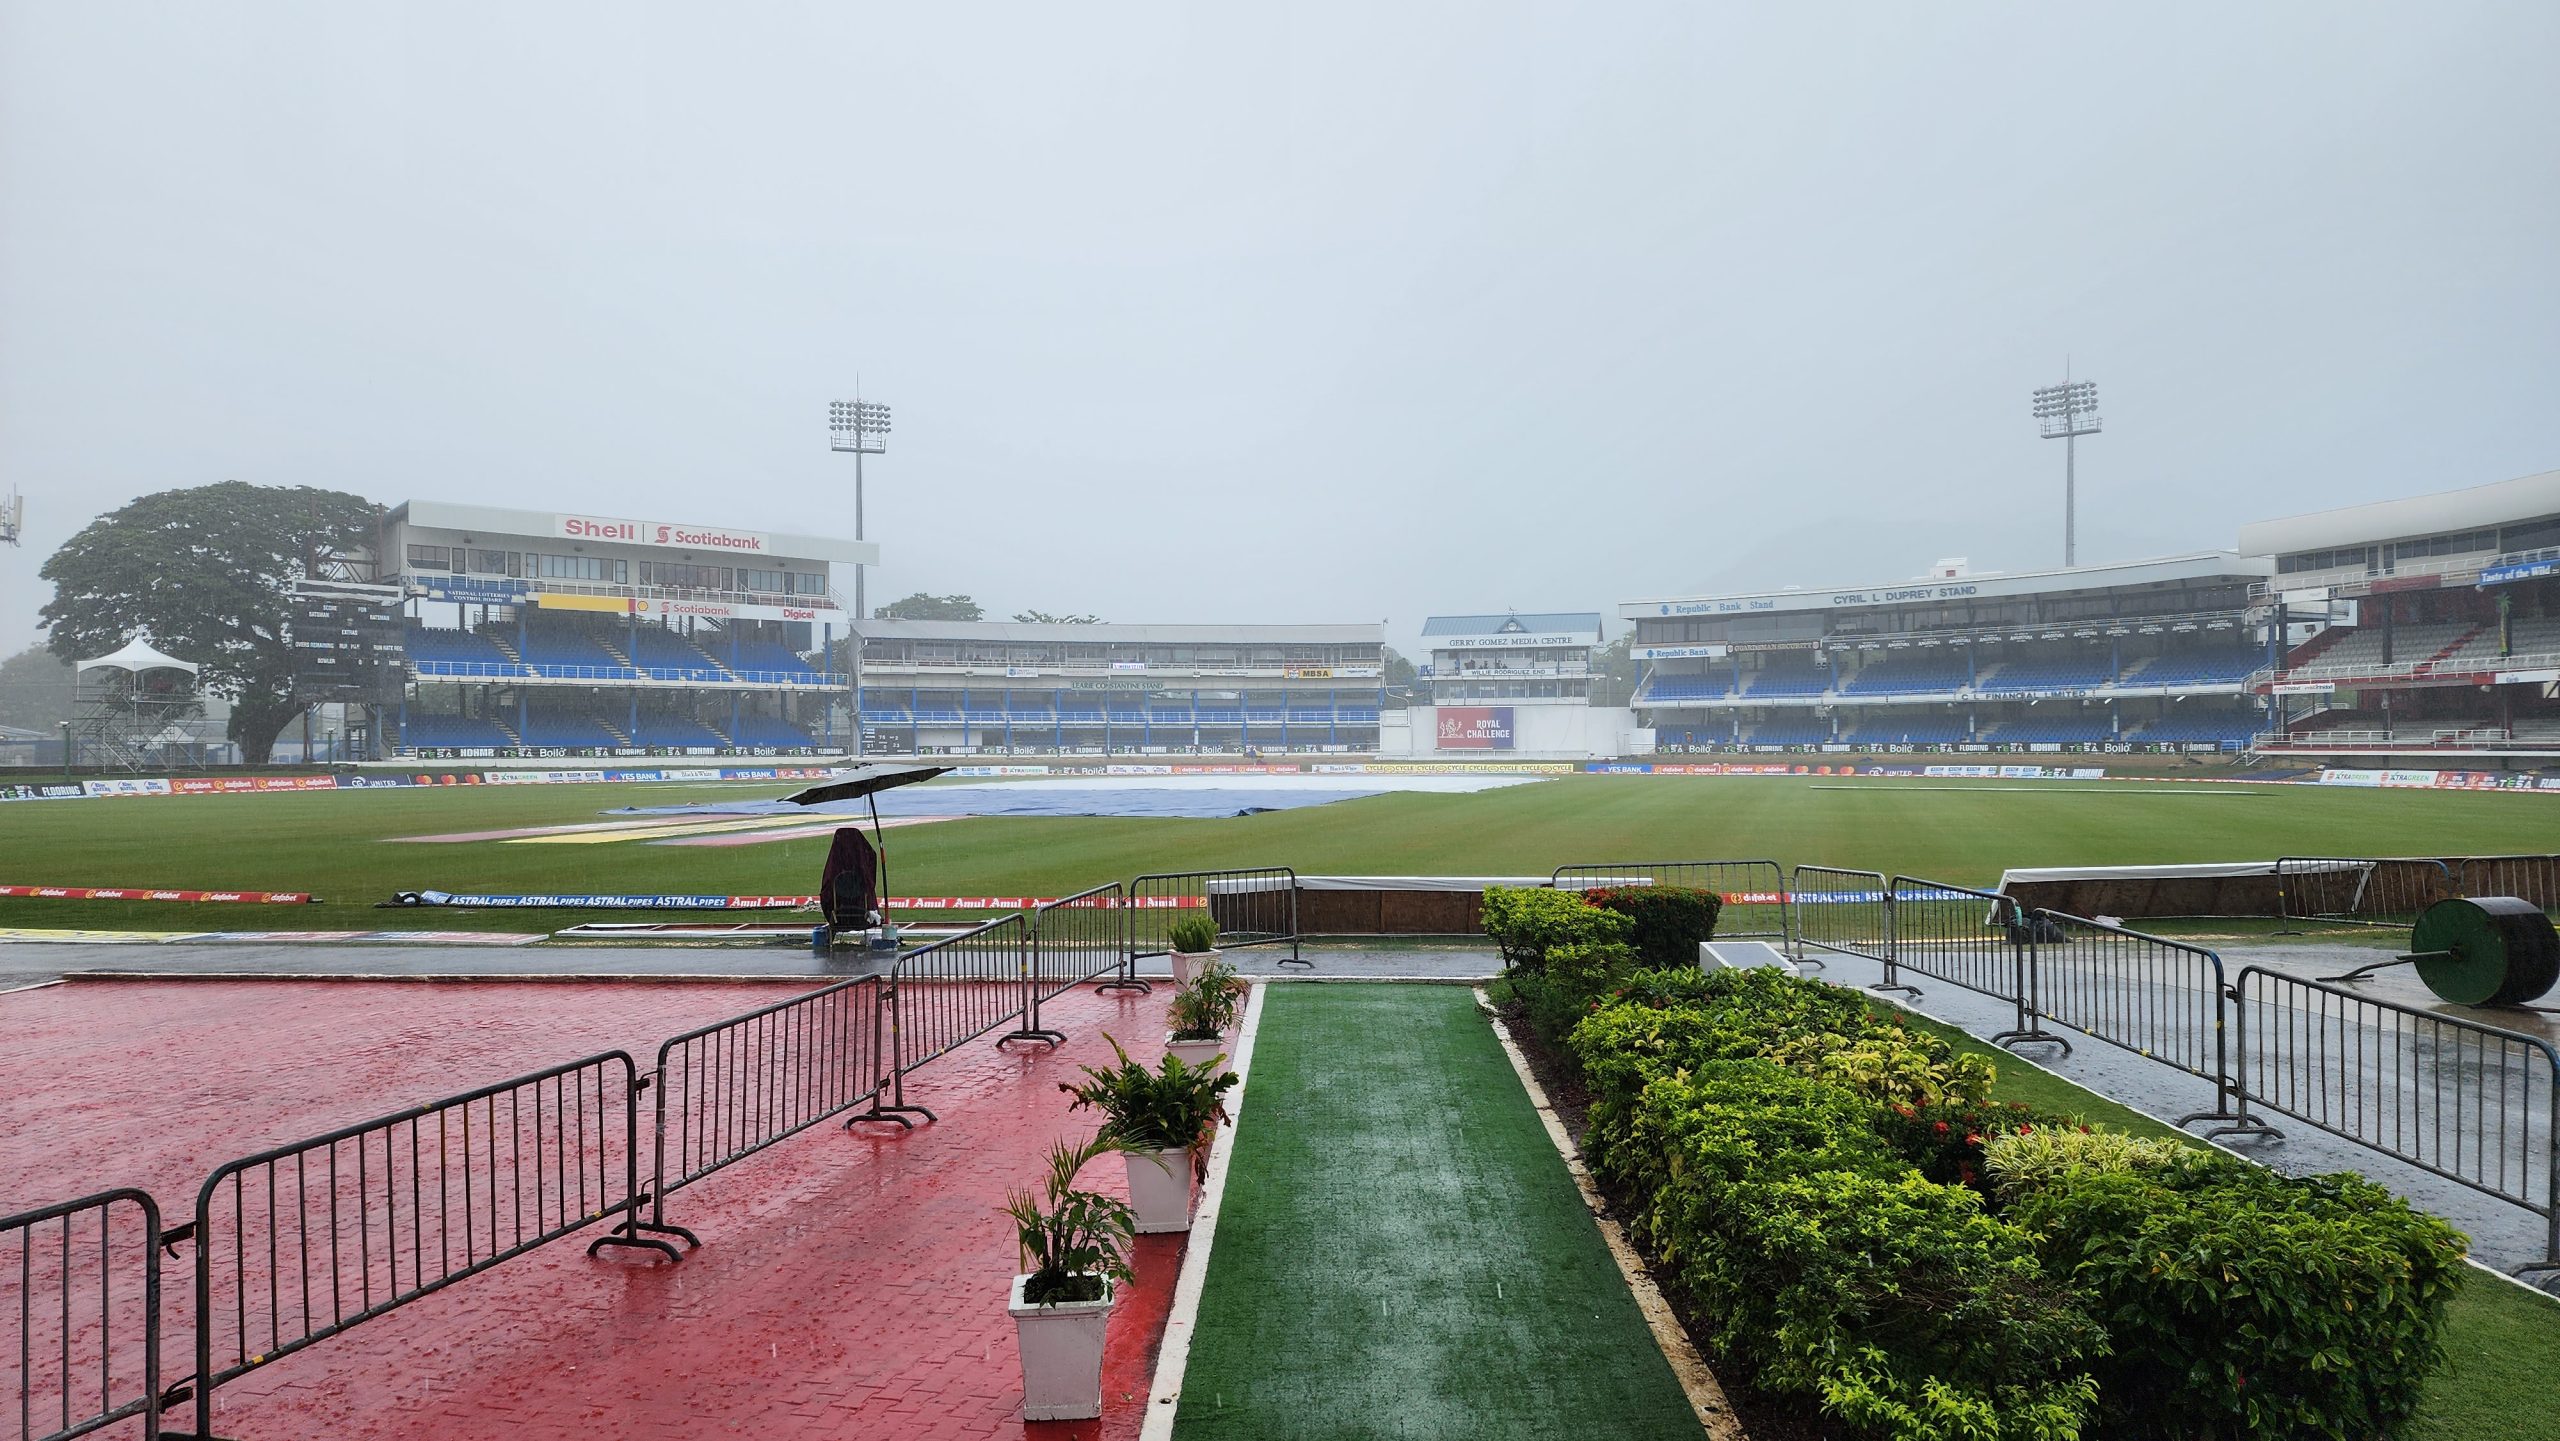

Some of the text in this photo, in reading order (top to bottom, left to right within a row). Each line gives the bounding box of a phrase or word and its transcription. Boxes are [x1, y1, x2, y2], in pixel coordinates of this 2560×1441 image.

[566, 519, 634, 540] Shell
[676, 530, 760, 550] Scotiabank
[2482, 572, 2503, 582] Taste
[2505, 570, 2516, 580] of
[2516, 568, 2529, 578] the
[2531, 565, 2550, 576] Wild
[1834, 586, 1976, 604] CYRIL L DUPREY STAND
[674, 604, 730, 615] Scotiabank
[1676, 600, 1773, 614] Republic Bank Stand
[784, 608, 815, 620] Digicel
[1477, 720, 1500, 729] ROYAL
[1467, 730, 1510, 738] CHALLENGE
[502, 749, 533, 757] TESA
[2390, 772, 2429, 781] XTRAGREEN
[184, 780, 212, 790] dafabet
[225, 780, 252, 789] dafabet
[268, 779, 294, 788] dafabet
[306, 777, 332, 786] dafabet
[2500, 779, 2532, 788] TESA
[42, 785, 80, 796] FLOORING
[153, 892, 181, 900] dafabet
[1744, 894, 1776, 902] dafabet
[451, 897, 492, 905] ASTRAL
[518, 897, 559, 905] ASTRAL
[586, 897, 626, 906] ASTRAL
[655, 897, 698, 906] ASTRAL
[730, 897, 761, 906] Amul
[765, 897, 796, 906] Amul
[913, 898, 946, 908] Amul
[952, 898, 986, 908] Amul
[989, 898, 1022, 908] Amul
[1144, 897, 1177, 907] Amul
